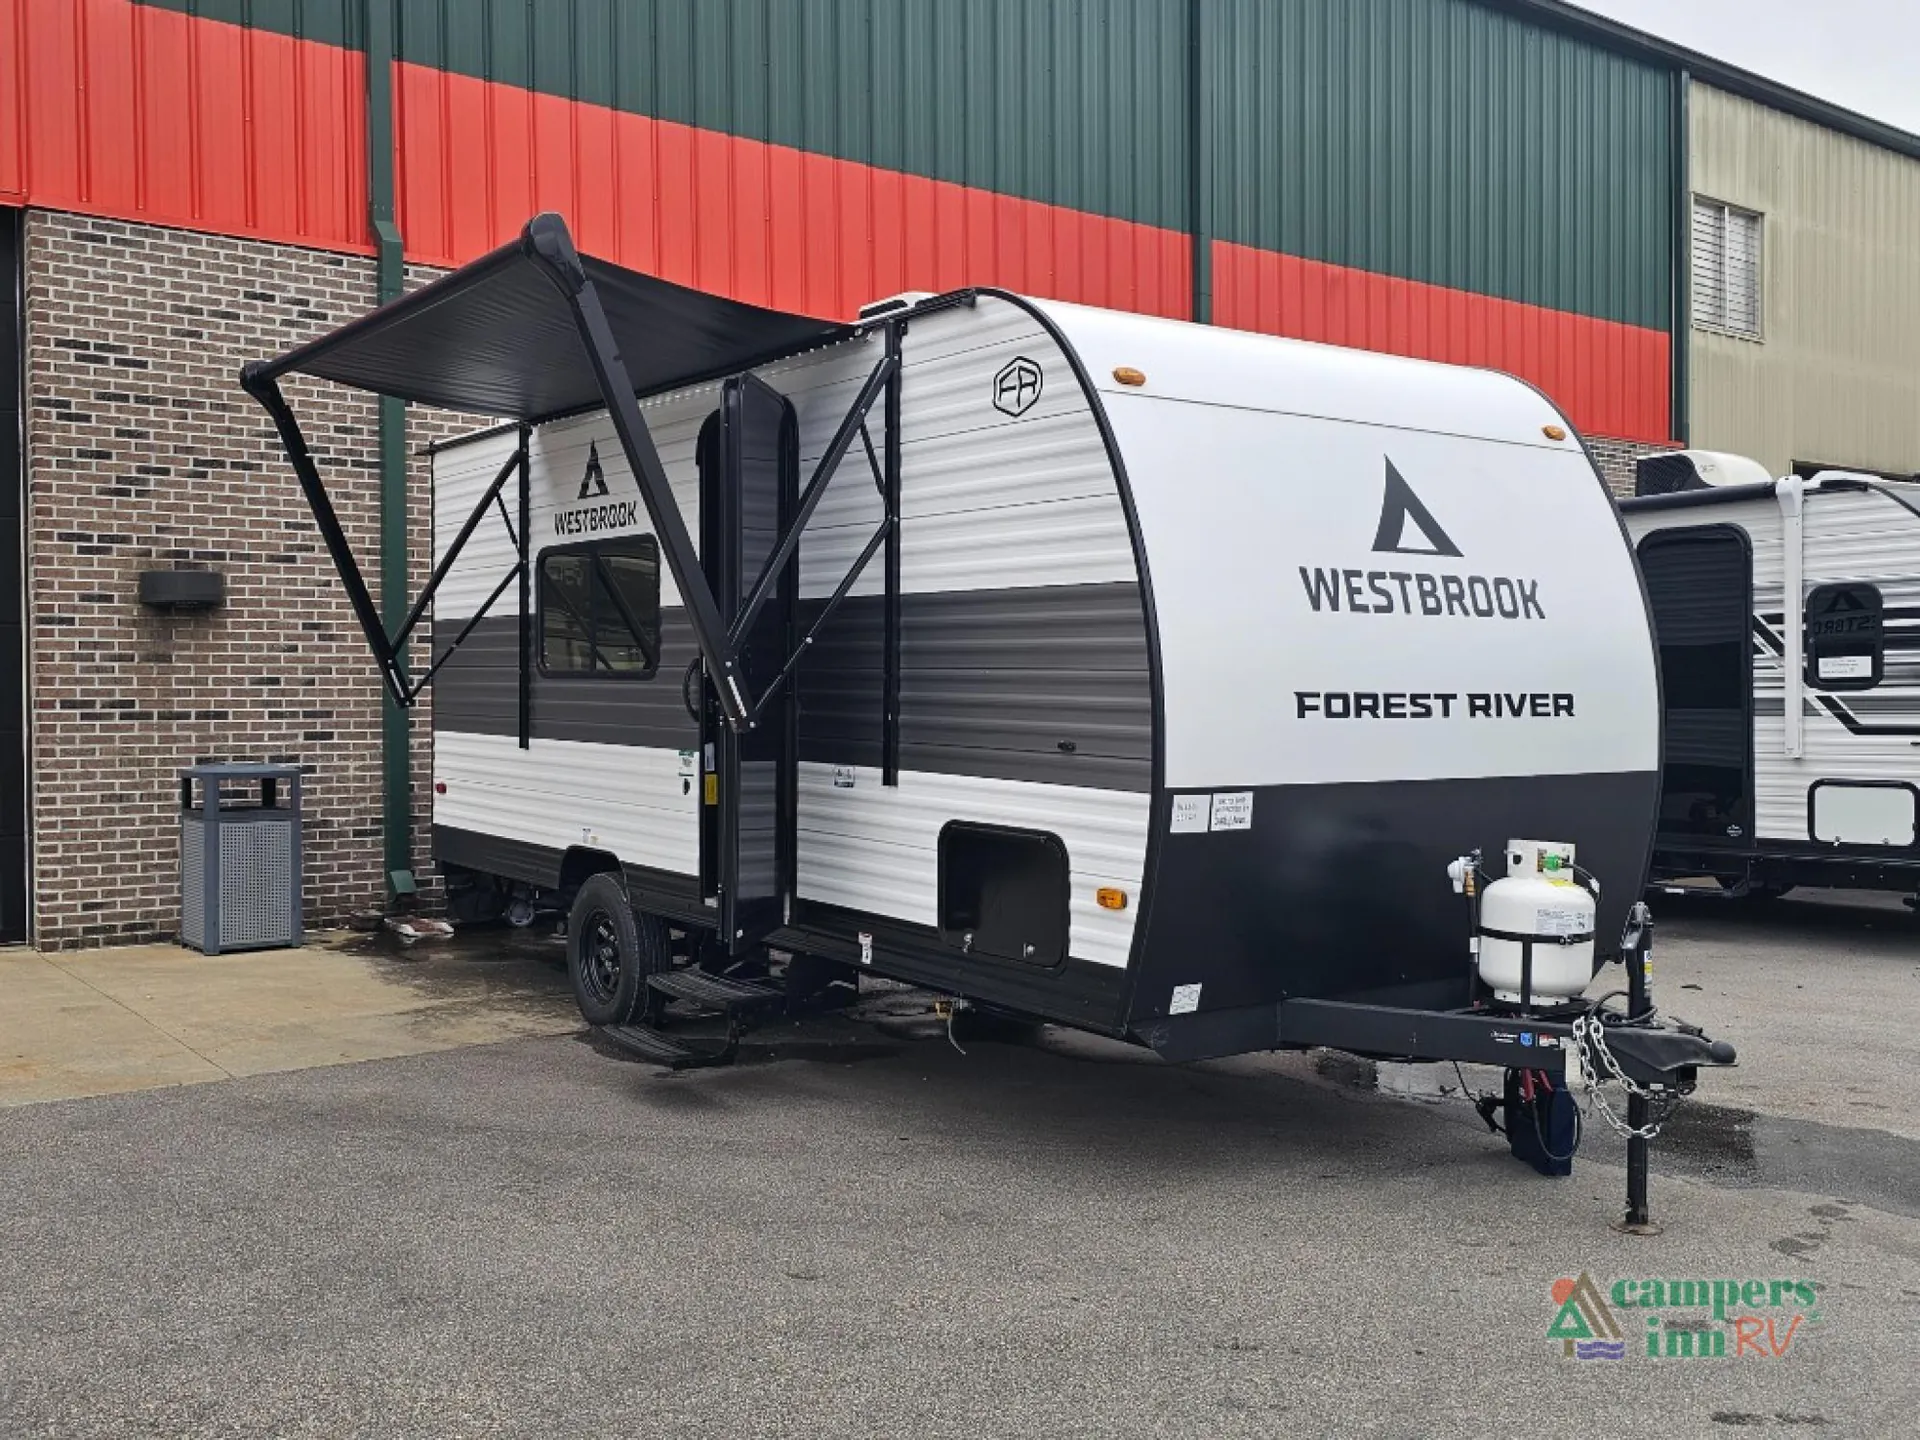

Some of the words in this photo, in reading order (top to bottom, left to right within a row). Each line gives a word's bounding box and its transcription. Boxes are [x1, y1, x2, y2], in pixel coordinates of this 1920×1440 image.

[554, 500, 638, 536] WESTBROOK
[1298, 565, 1546, 619] WESTBROOK
[1293, 691, 1458, 719] FOREST
[1465, 692, 1575, 718] RIVER
